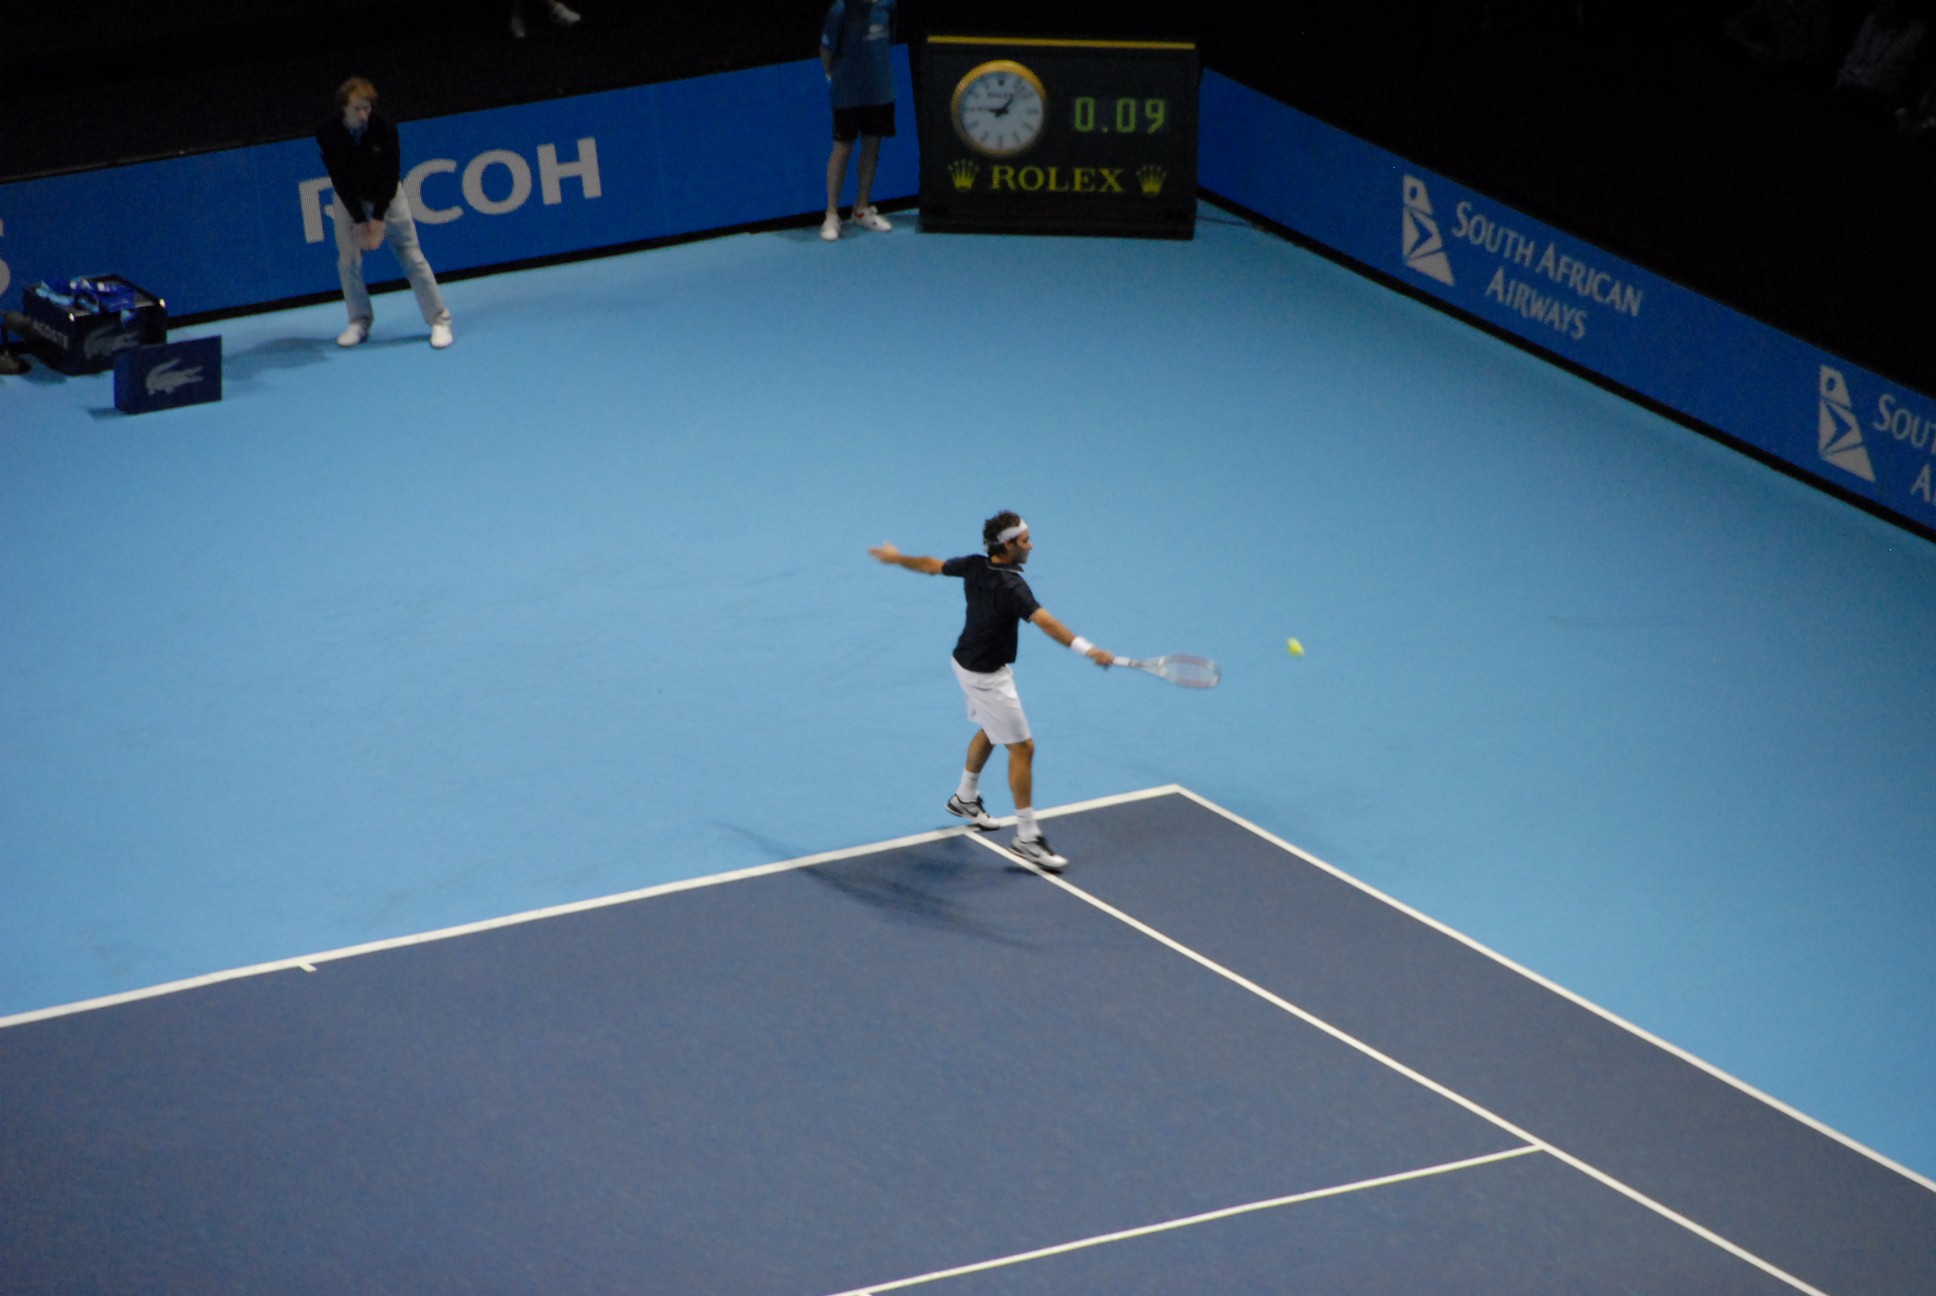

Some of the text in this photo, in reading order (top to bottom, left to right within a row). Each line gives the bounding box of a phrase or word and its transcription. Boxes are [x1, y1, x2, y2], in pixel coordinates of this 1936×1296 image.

[1074, 97, 1165, 133] 0.09
[298, 137, 602, 244] RCOH
[990, 165, 1124, 193] ROLEX
[1451, 201, 1644, 317] SOUTH AFRICAN
[1484, 266, 1588, 340] AIRWAYS
